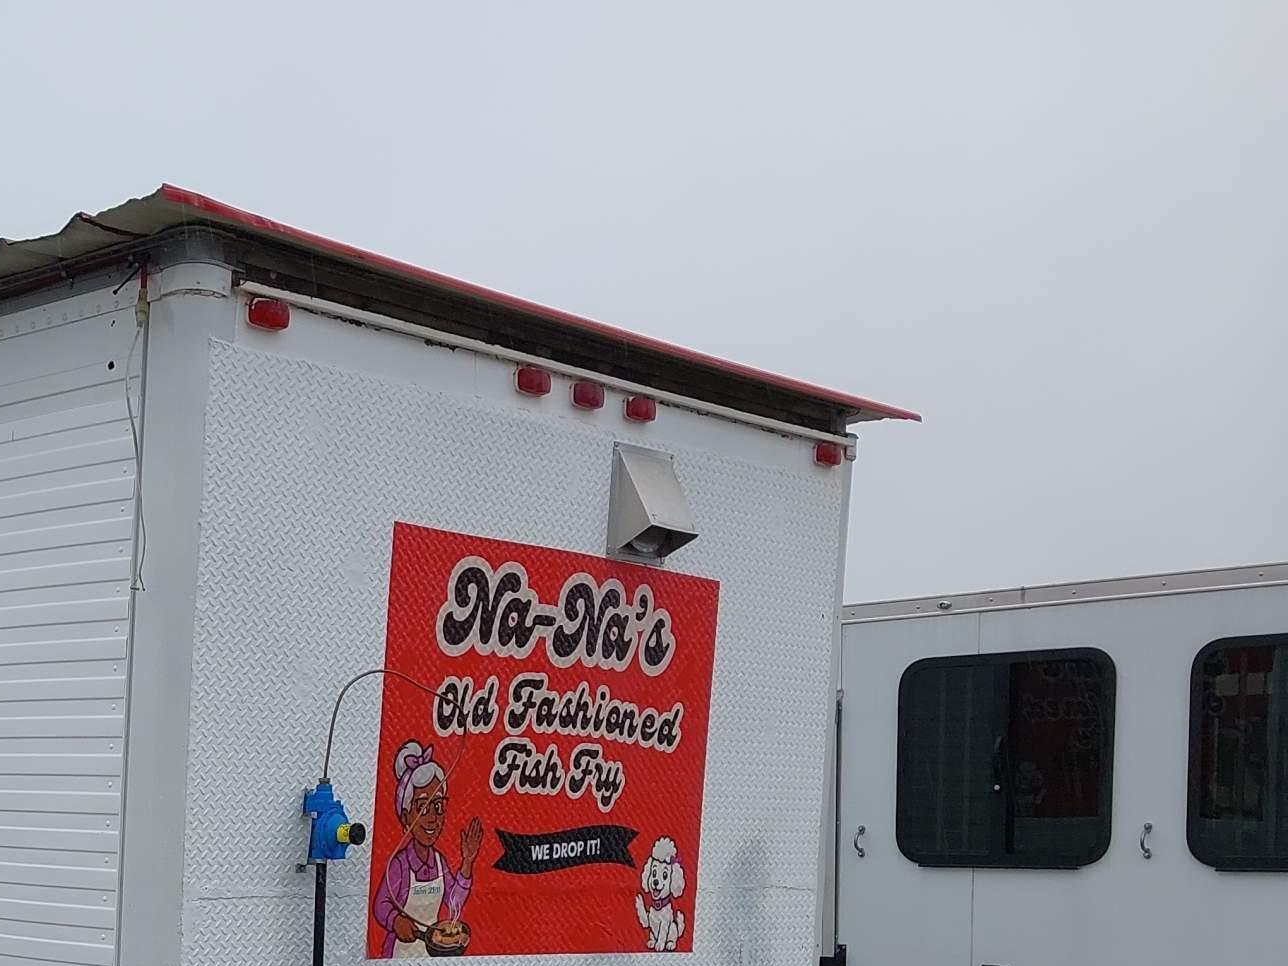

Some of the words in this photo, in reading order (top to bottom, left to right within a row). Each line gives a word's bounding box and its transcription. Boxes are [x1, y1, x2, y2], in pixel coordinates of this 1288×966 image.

[439, 560, 673, 672] Na-Na's
[435, 679, 496, 734] Old
[507, 675, 683, 750] Fashioned
[491, 739, 561, 793] Fish
[568, 746, 623, 809] Fry
[531, 844, 550, 860] WE
[552, 841, 585, 859] DROP
[586, 838, 601, 856] IT!
